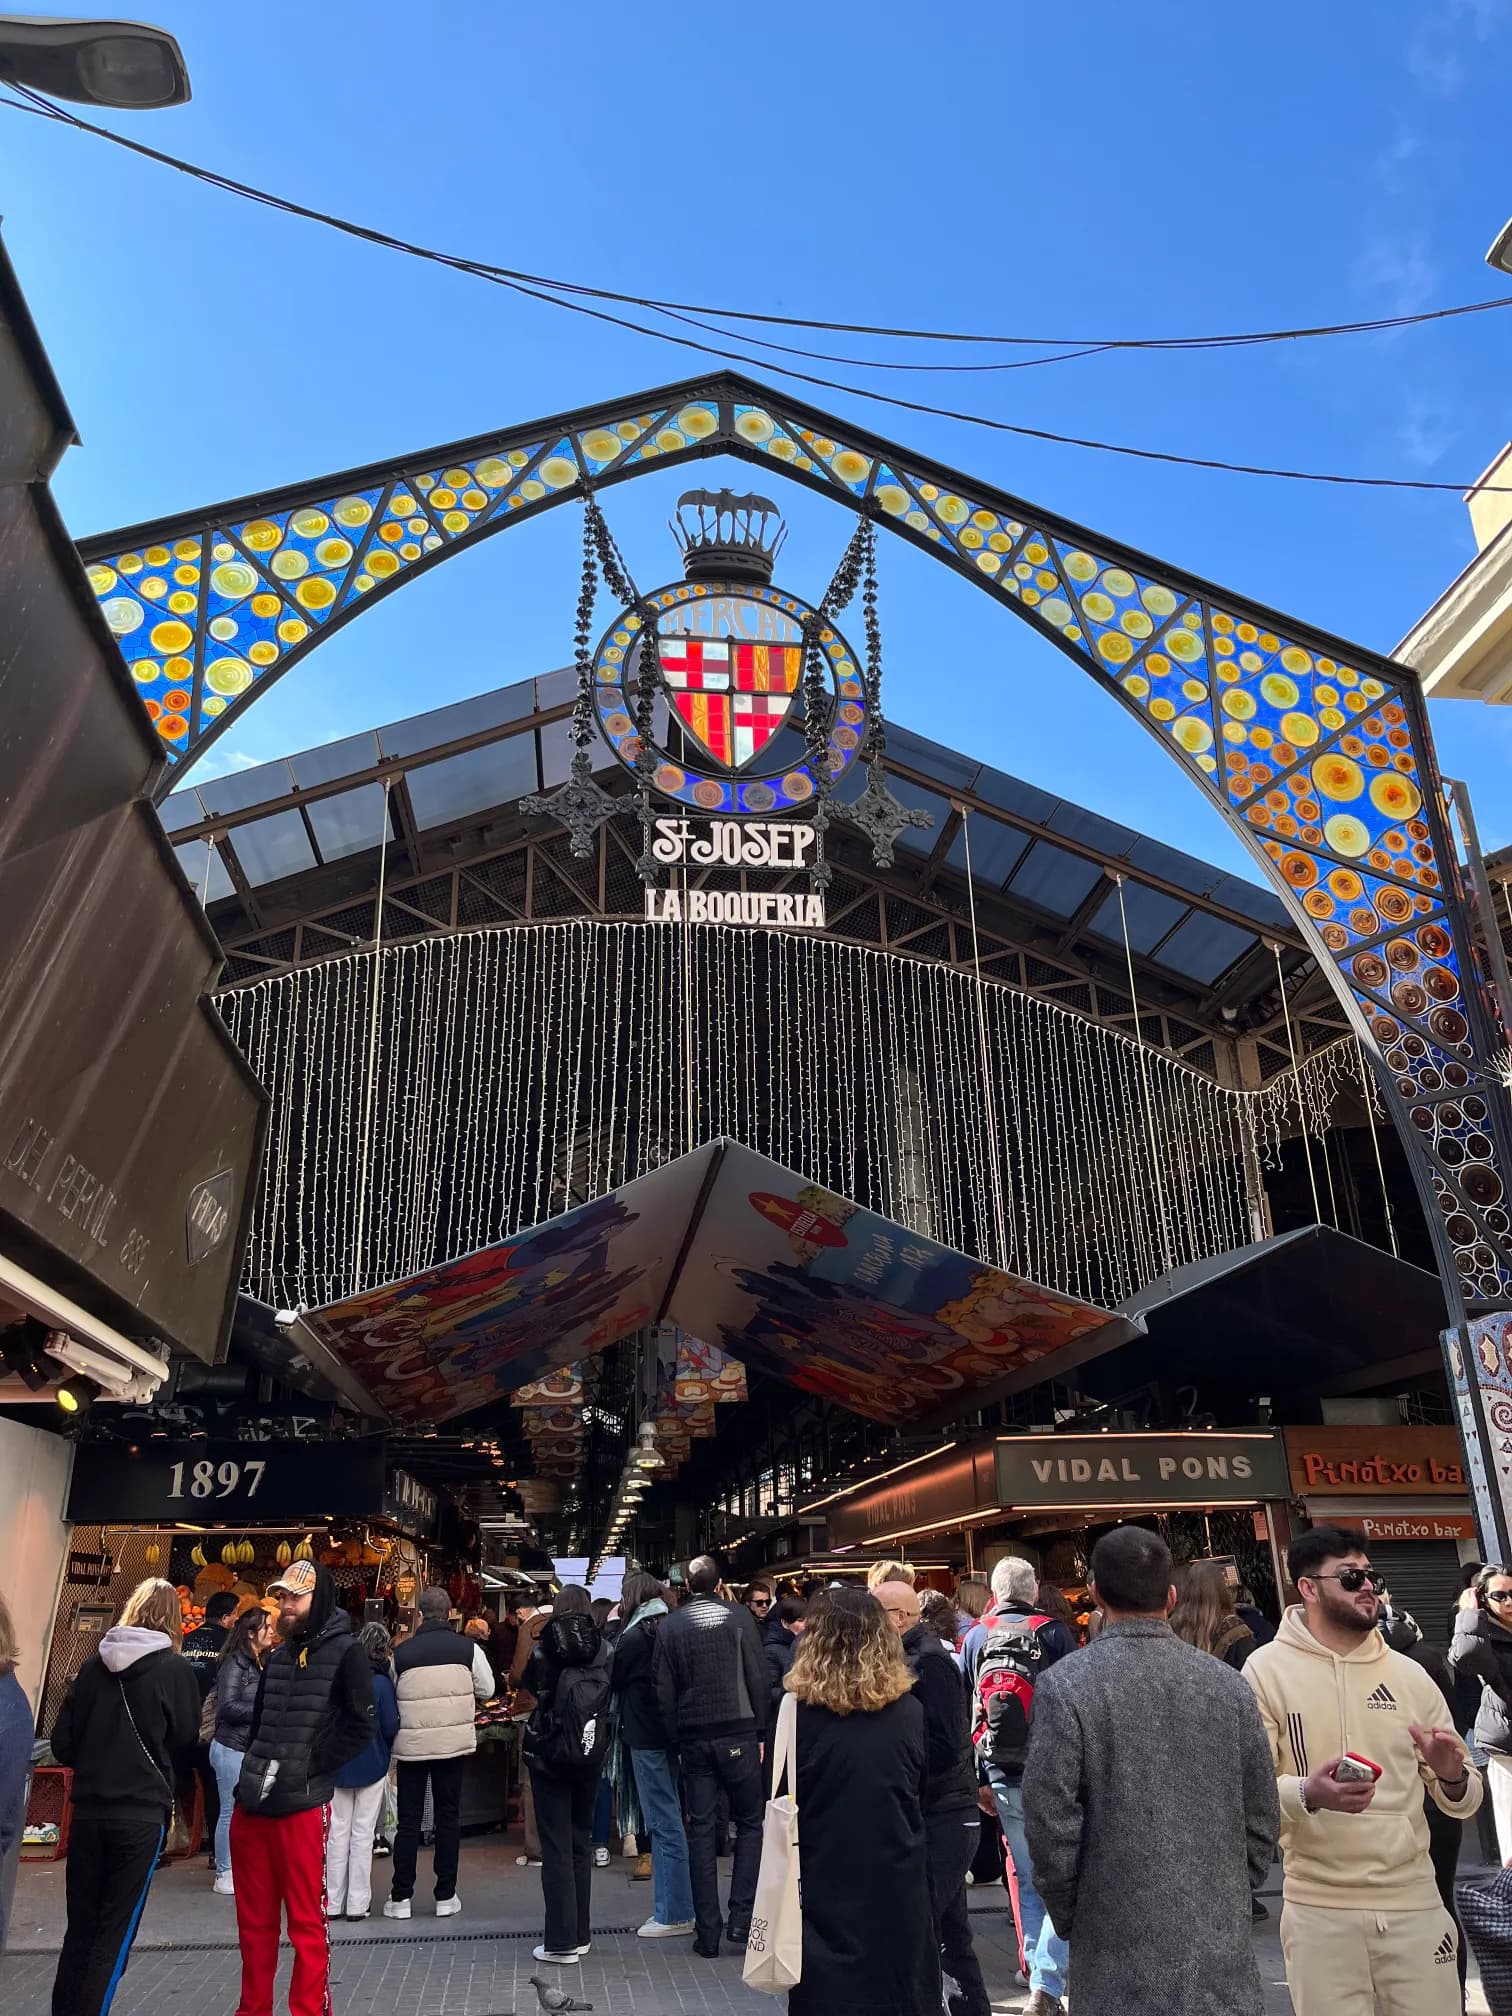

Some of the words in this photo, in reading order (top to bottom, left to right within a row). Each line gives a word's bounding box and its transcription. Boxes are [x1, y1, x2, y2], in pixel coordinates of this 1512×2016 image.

[664, 598, 800, 643] MERCAT
[690, 819, 815, 867] JOSEP
[646, 889, 681, 921] LA
[689, 890, 826, 926] BOQUERIA
[166, 1460, 267, 1499] 1897
[1031, 1457, 1141, 1483] VIDAL
[1158, 1455, 1253, 1481] PONS
[1429, 1457, 1467, 1484] ba
[1433, 1522, 1463, 1537] bar
[1367, 1701, 1397, 1711] adidas
[751, 1916, 769, 1931] 022
[1434, 1953, 1456, 1965] adida
